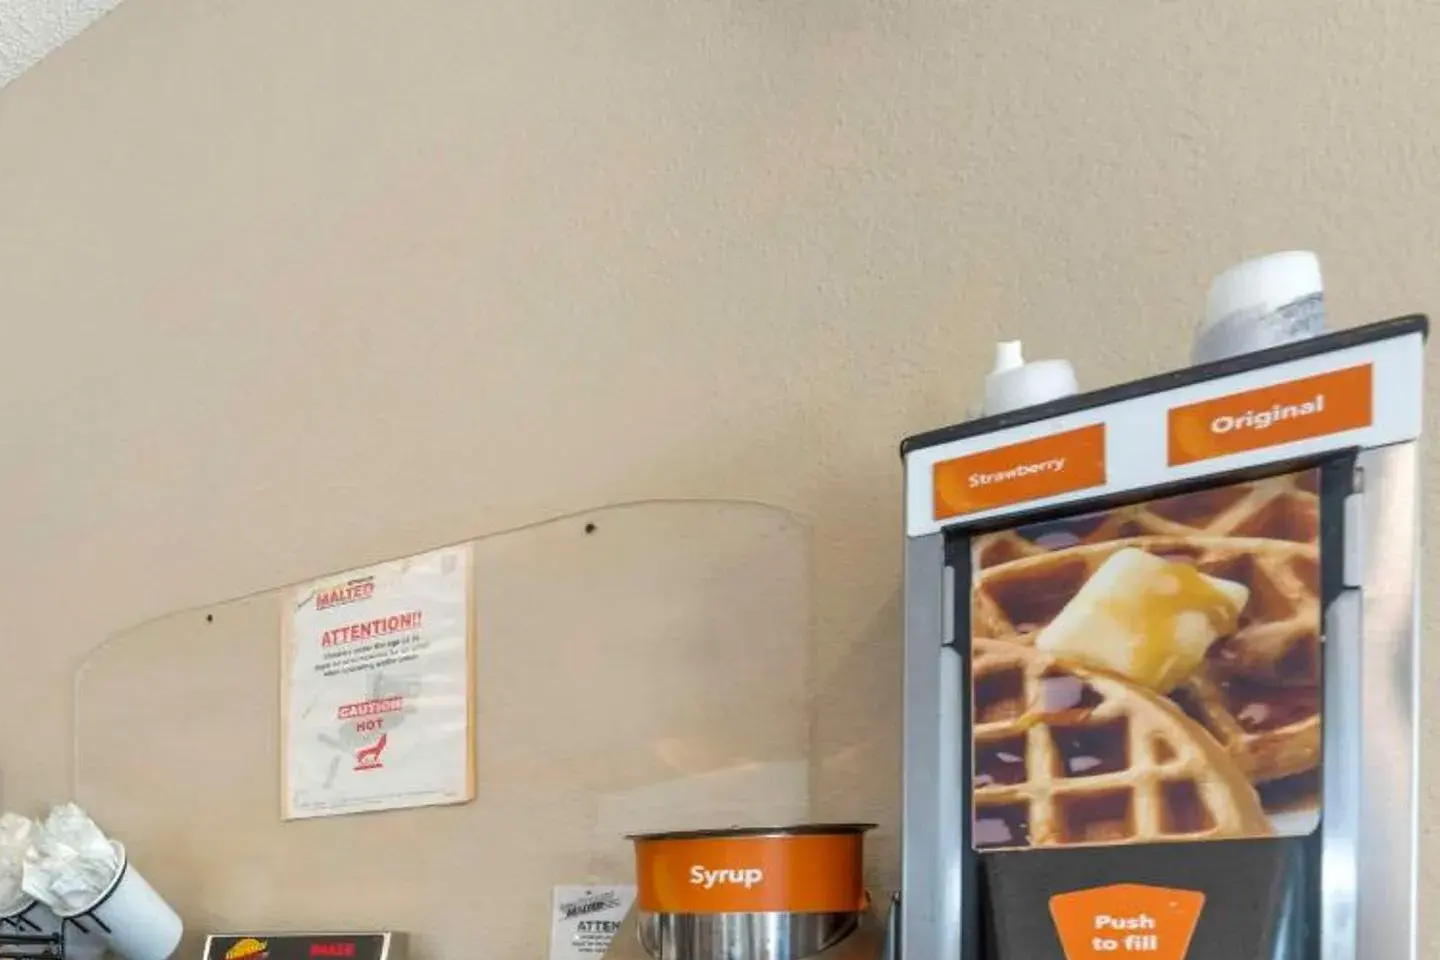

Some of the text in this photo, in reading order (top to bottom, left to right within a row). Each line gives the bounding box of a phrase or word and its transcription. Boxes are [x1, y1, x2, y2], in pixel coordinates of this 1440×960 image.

[1211, 394, 1325, 433] Original
[967, 458, 1065, 488] Strawberry
[316, 583, 375, 609] MALTED
[322, 611, 422, 647] ATTENTION!!
[339, 697, 402, 718] CAUTION
[356, 719, 384, 732] HOT
[689, 865, 763, 889] Syrup
[577, 920, 622, 933] ATTEN
[1094, 912, 1157, 930] Push
[1092, 934, 1158, 952] to fill
